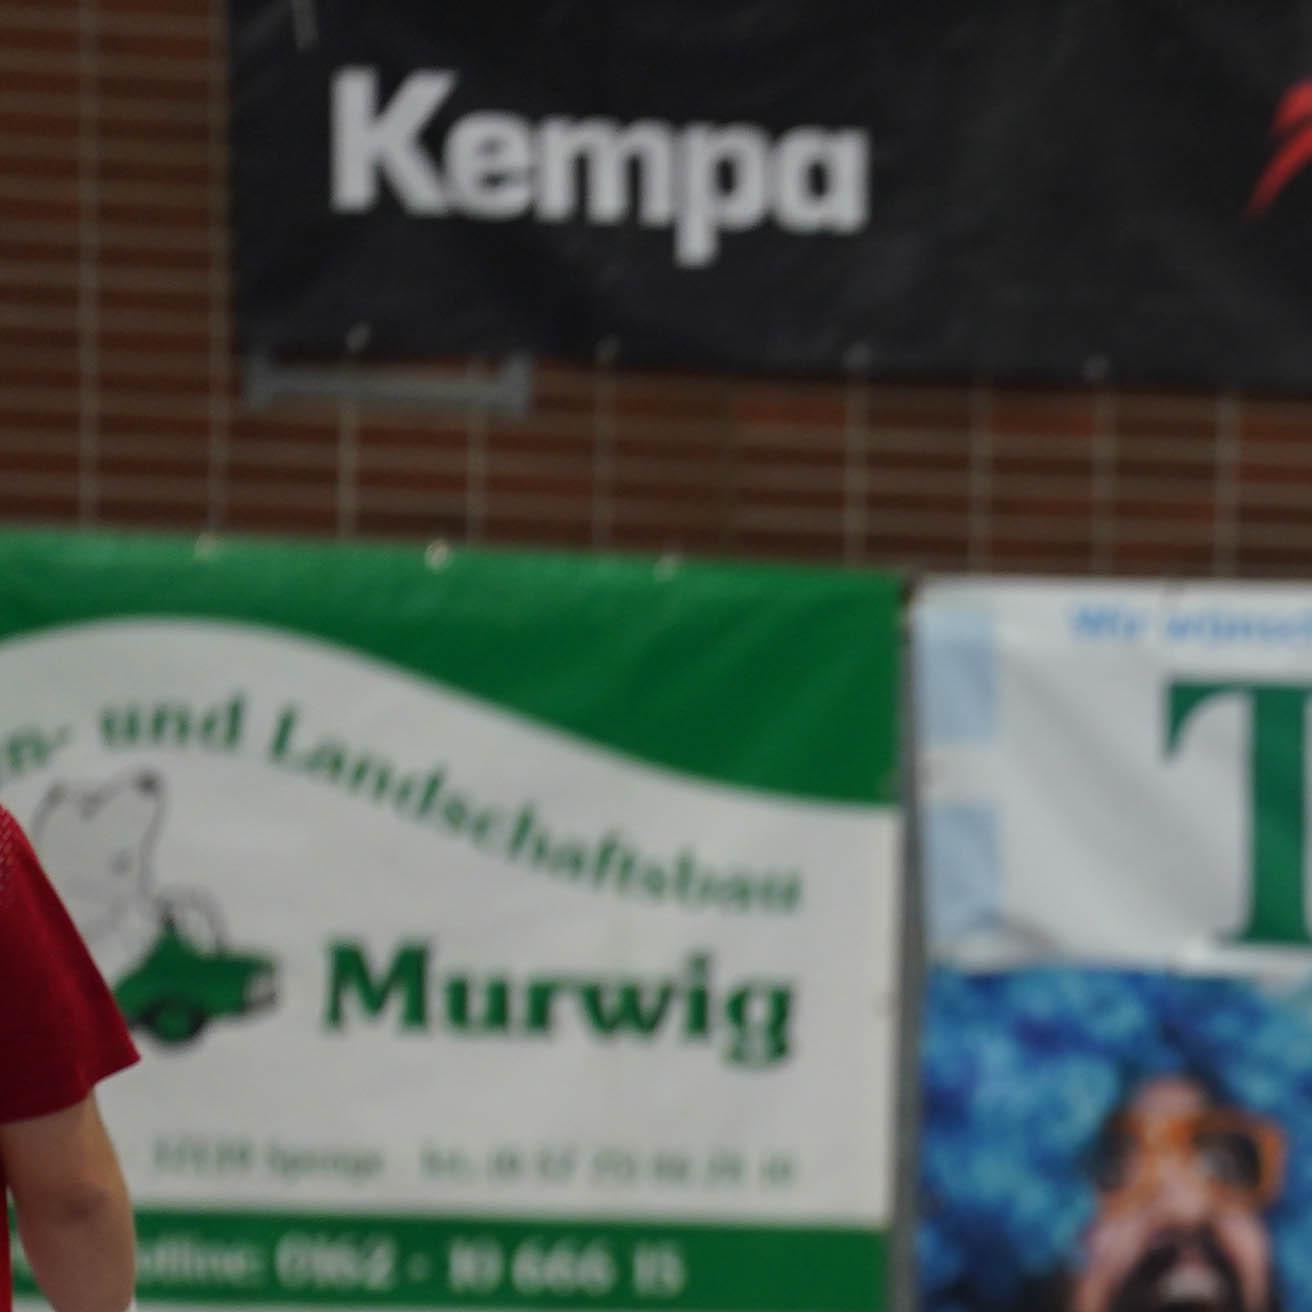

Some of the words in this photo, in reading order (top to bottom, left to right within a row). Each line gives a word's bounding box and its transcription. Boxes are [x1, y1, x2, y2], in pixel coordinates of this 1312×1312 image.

[331, 66, 868, 268] Kempa
[99, 690, 248, 753] und
[268, 702, 803, 916] Landschaftsbau
[321, 938, 795, 1070] Murwig
